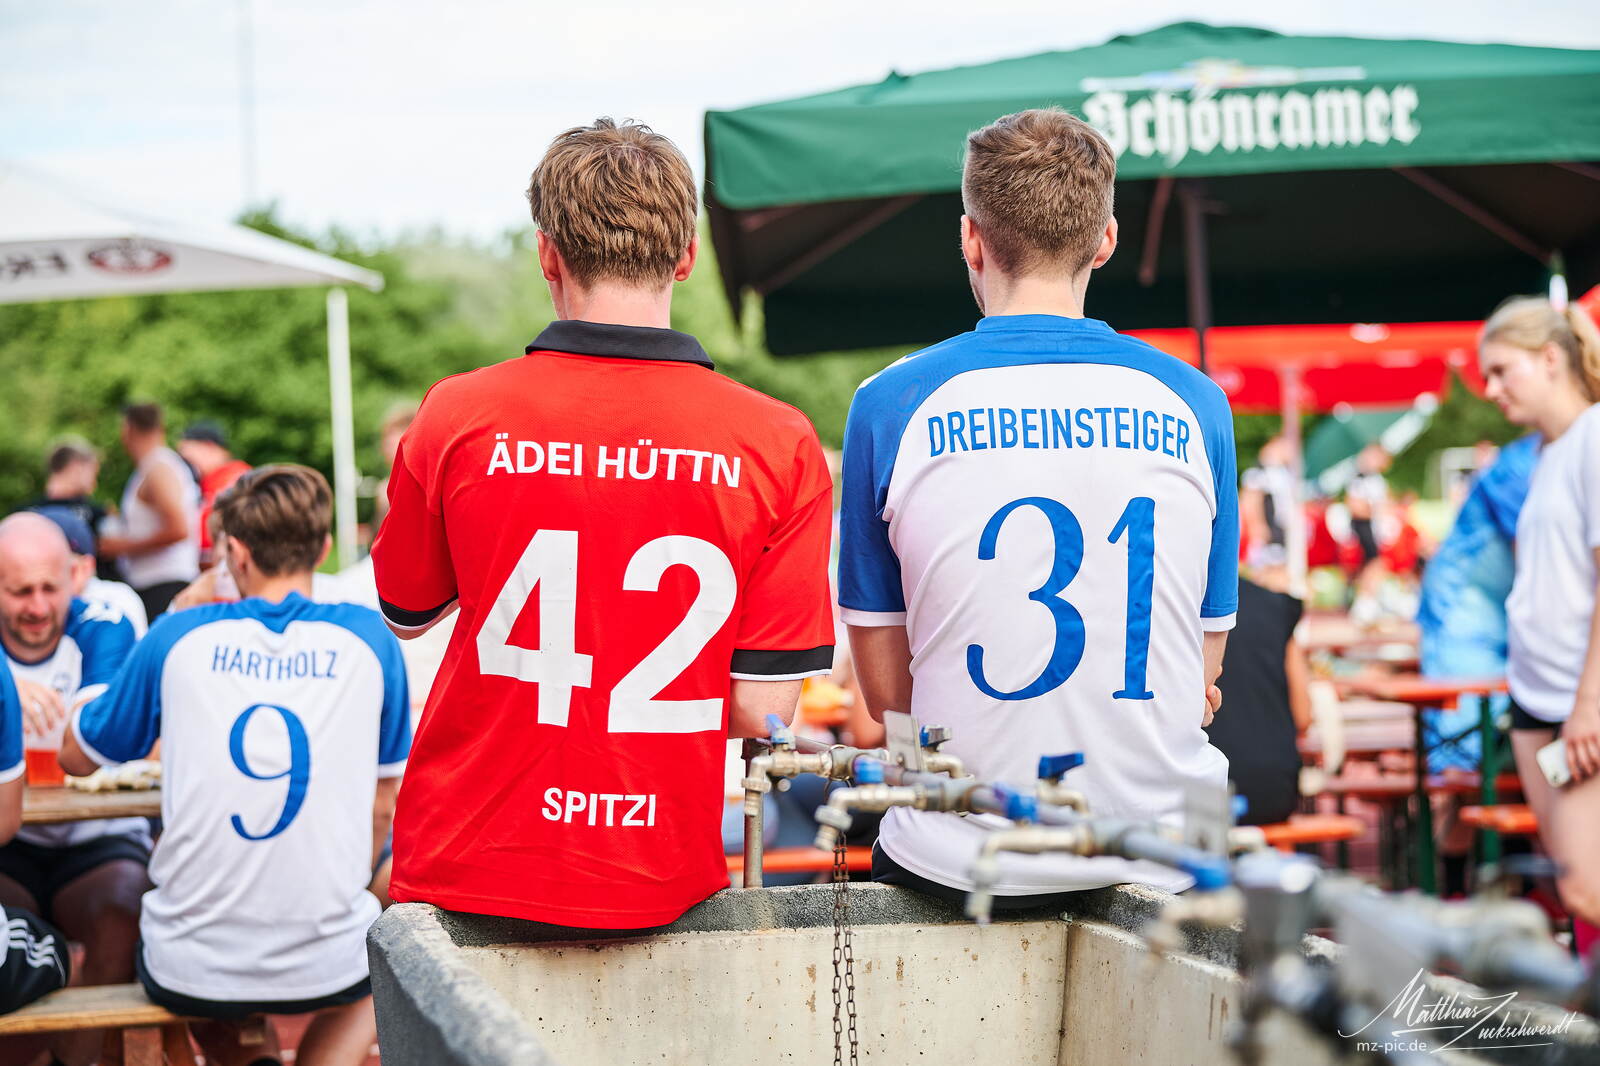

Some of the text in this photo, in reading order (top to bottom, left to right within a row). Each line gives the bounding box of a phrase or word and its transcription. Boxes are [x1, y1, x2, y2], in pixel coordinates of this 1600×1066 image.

[1083, 84, 1421, 168] Schönramer
[487, 433, 741, 488] ÄDEI HÜTTN
[928, 407, 1189, 463] DREIBEINSTEIGER
[476, 529, 738, 734] 42
[966, 496, 1156, 701] 31
[211, 645, 337, 681] HARTHOLZ
[229, 703, 311, 841] 9
[541, 787, 657, 828] SPITZI
